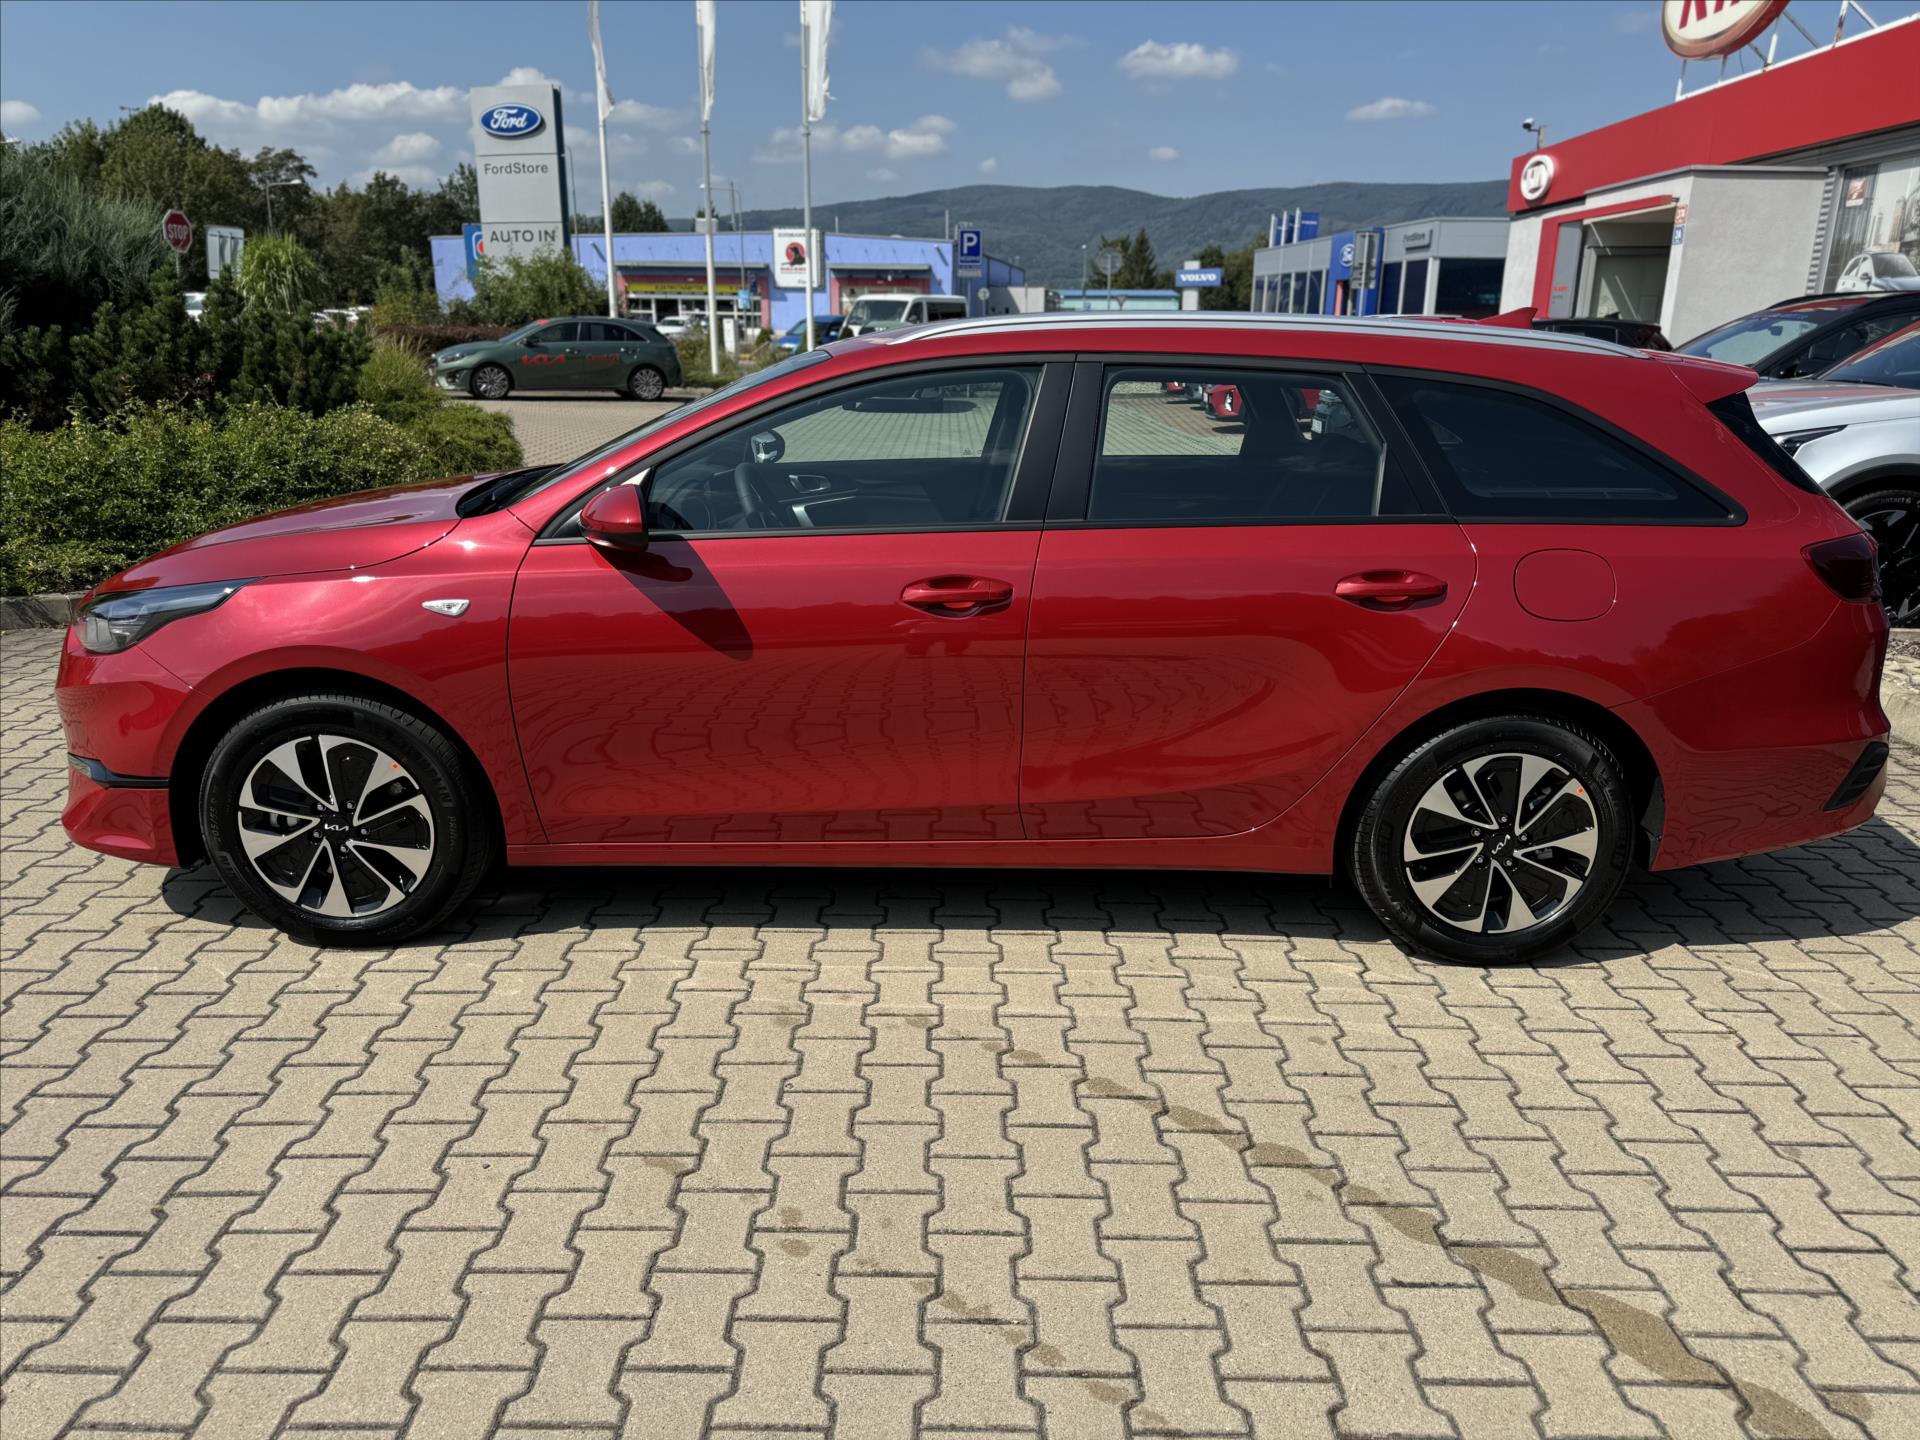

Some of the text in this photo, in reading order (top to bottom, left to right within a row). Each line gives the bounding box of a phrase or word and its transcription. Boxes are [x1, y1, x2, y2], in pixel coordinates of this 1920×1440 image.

[490, 108, 529, 130] Ford
[484, 162, 549, 175] FordStore
[167, 223, 189, 241] STOP
[490, 230, 557, 243] AUTO IN
[963, 233, 978, 254] P
[1180, 273, 1217, 282] VOLVO
[324, 823, 350, 832] KIA
